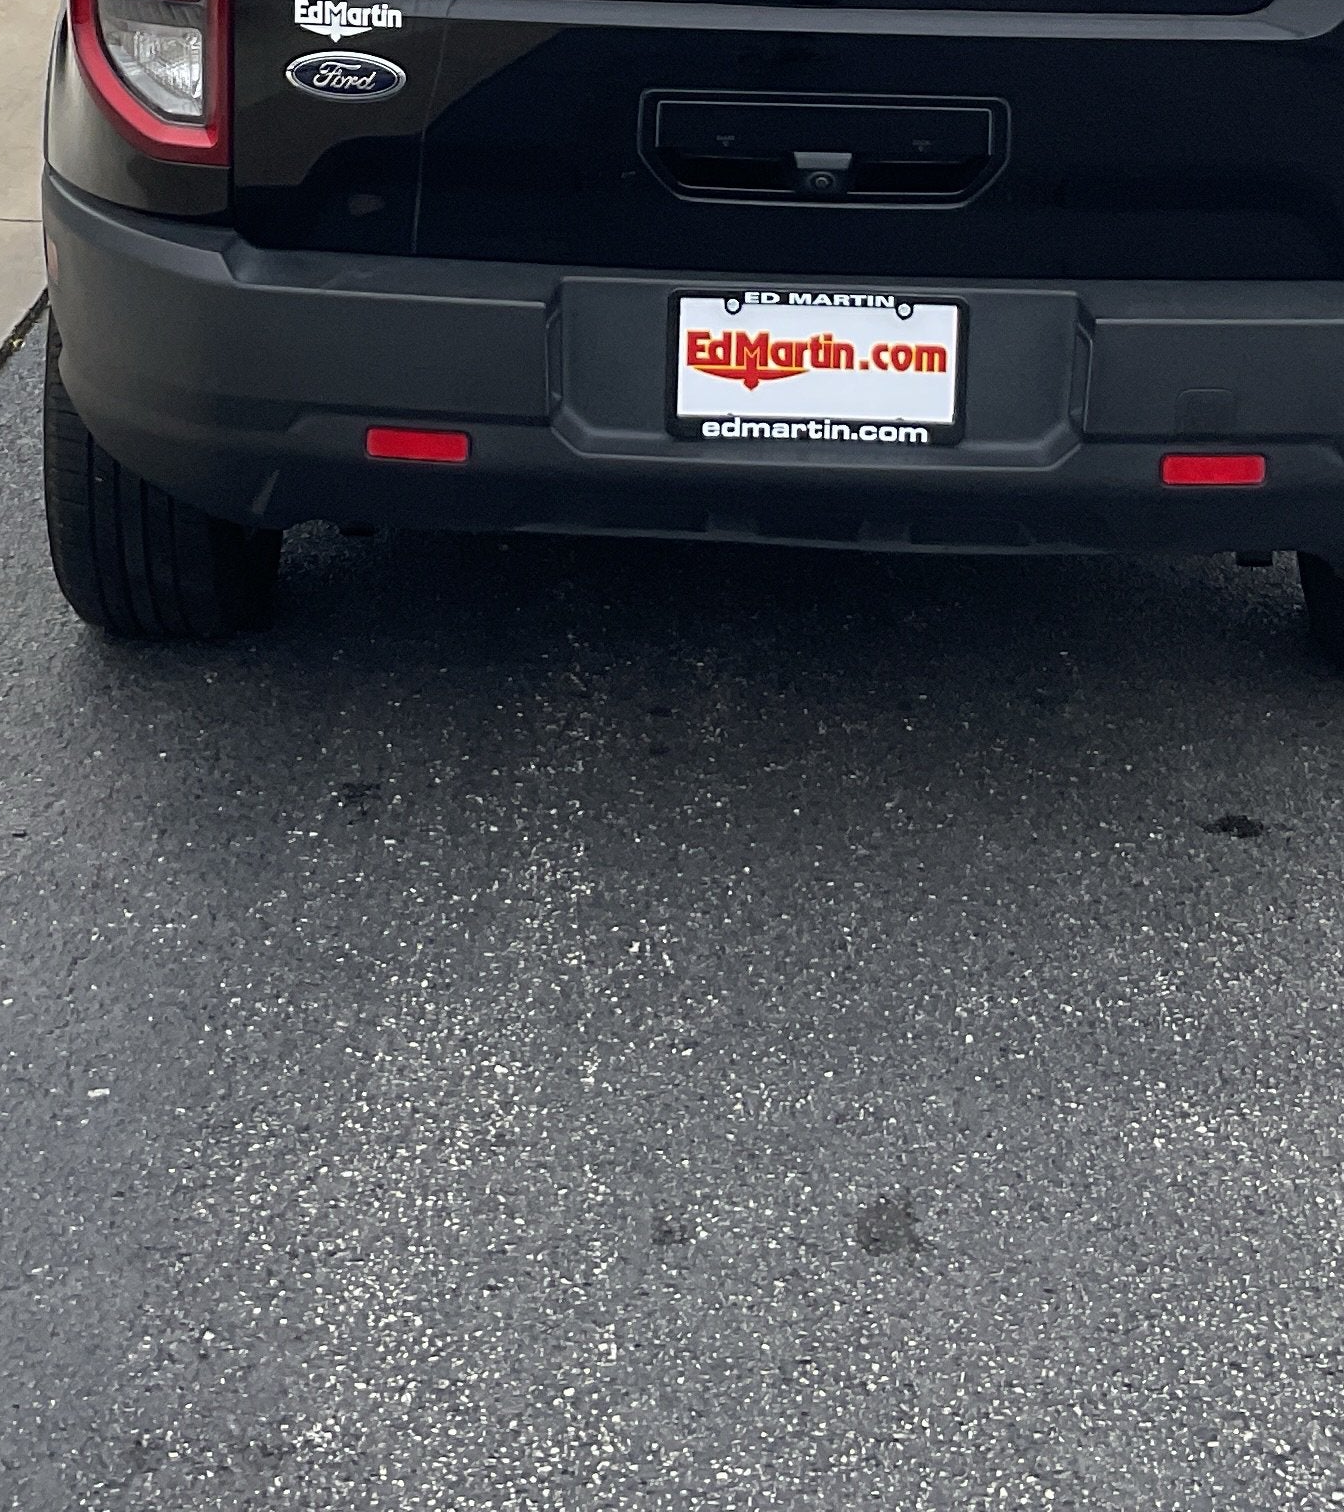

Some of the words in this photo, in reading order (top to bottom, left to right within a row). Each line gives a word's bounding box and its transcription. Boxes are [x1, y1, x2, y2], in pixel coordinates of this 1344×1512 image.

[294, 0, 403, 29] EdMartin
[312, 61, 378, 90] Ford
[744, 291, 781, 305] ED
[788, 292, 895, 308] MARTIN
[686, 330, 948, 374] EdMartin.com
[701, 417, 929, 443] edmartin.com
